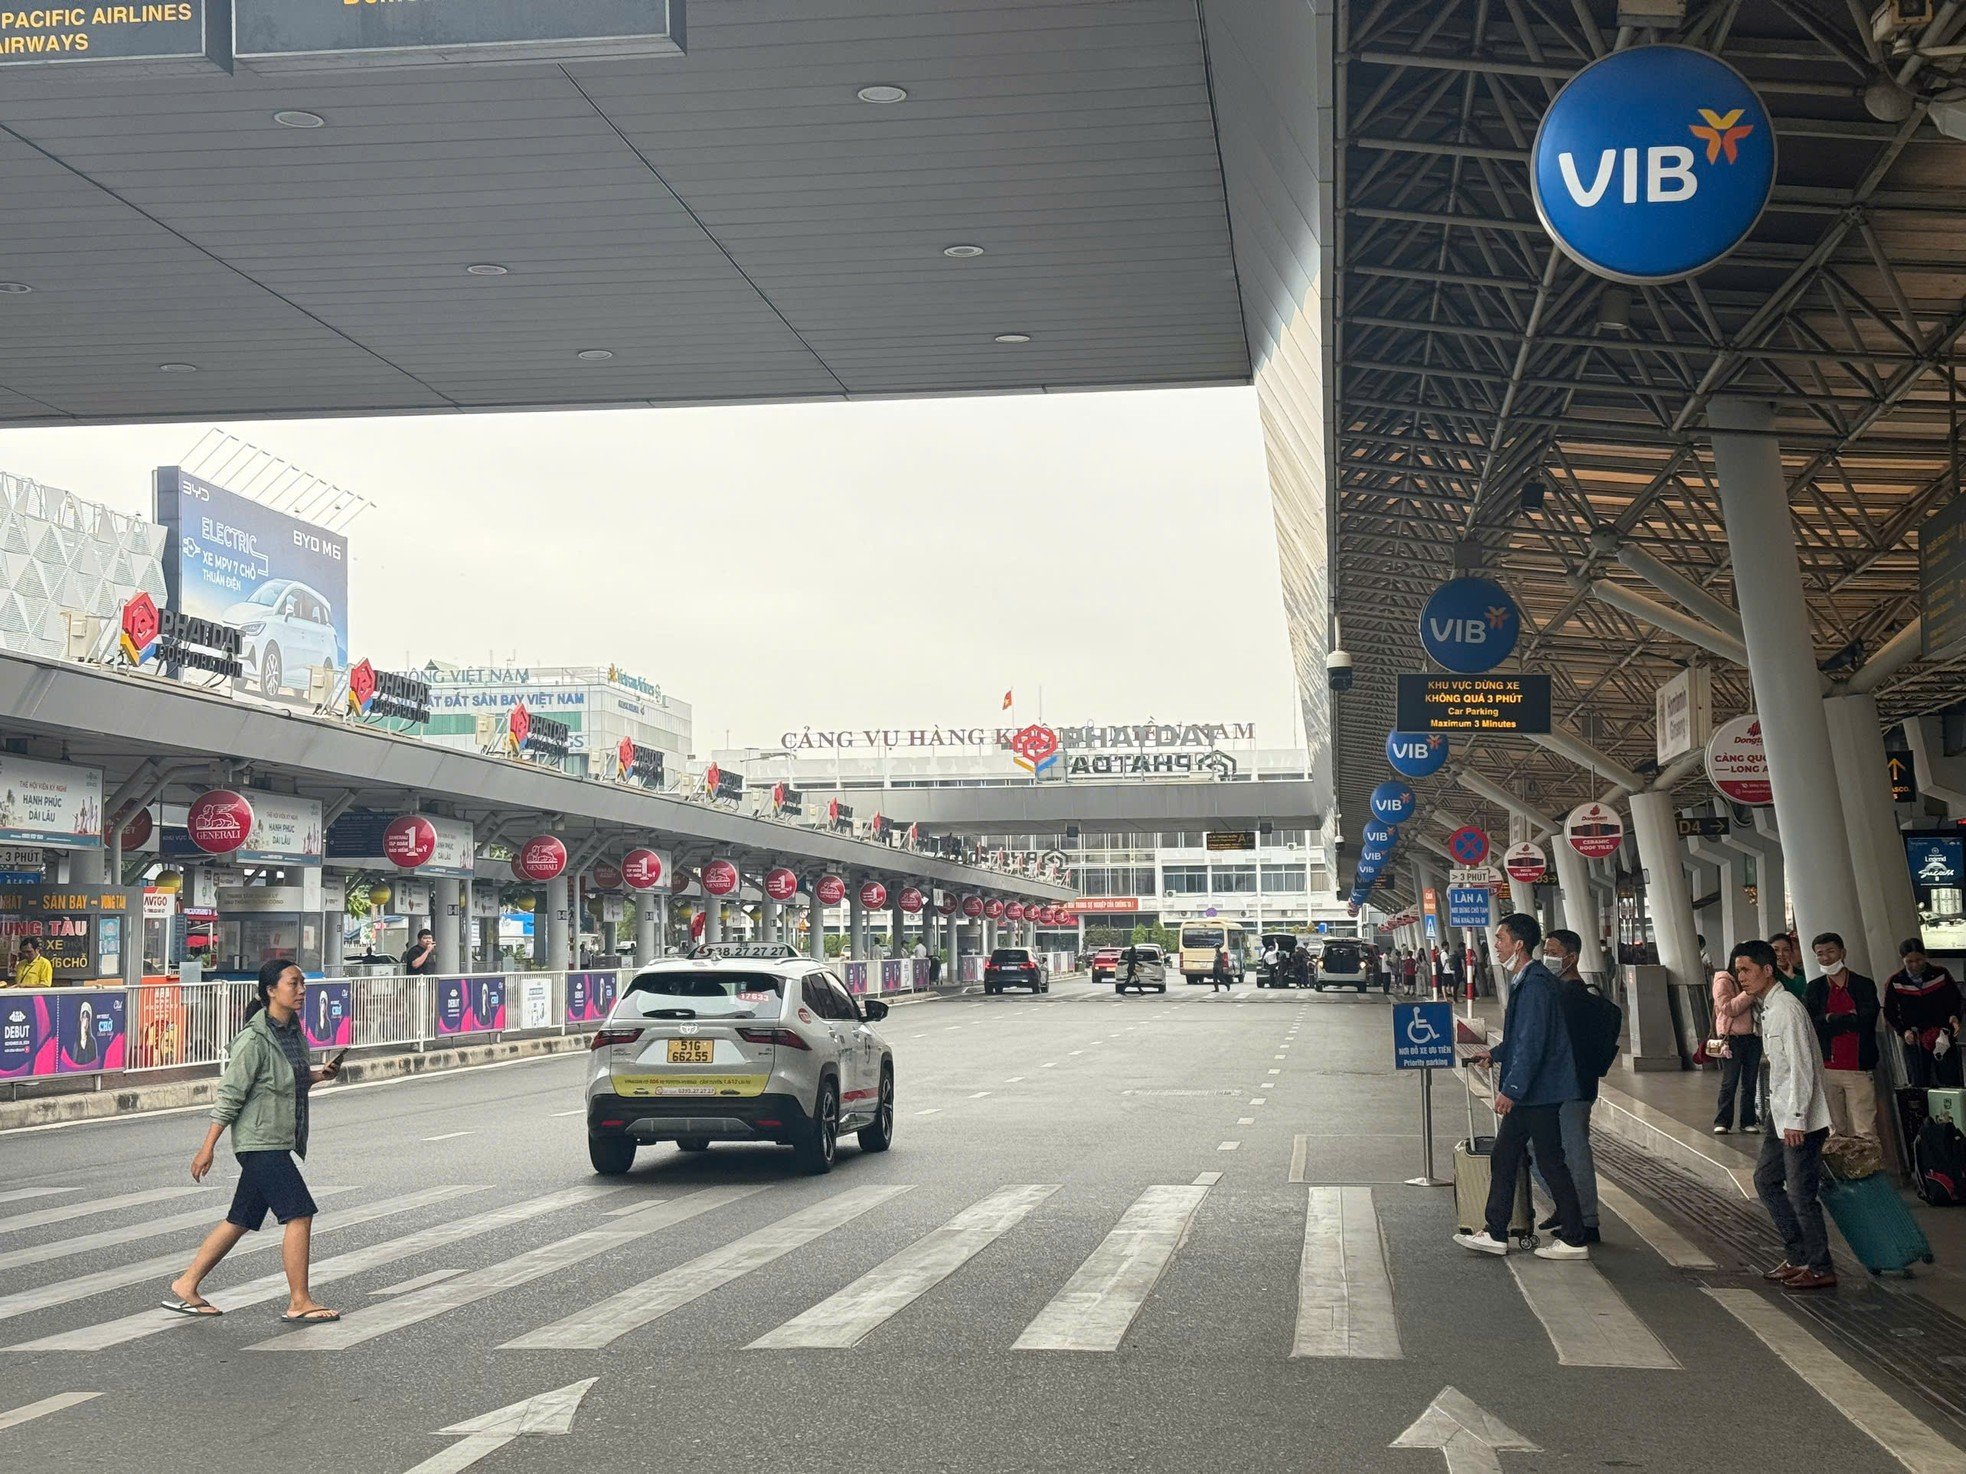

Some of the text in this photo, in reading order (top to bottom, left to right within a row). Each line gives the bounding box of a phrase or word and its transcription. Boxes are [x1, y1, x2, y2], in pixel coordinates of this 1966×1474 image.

[1, 3, 192, 30] PACIFIC AIRLINES
[1558, 145, 1698, 208] VIB
[202, 517, 258, 556] ELECTRIC
[293, 530, 342, 560] BYD M6
[202, 550, 214, 565] XE
[215, 555, 233, 573] MPV
[1430, 618, 1487, 644] VIB
[490, 668, 530, 684] NAM
[1428, 679, 1520, 691] KHU VỰC DỪNG XE
[500, 693, 525, 706] BAY
[557, 693, 585, 705] NAM
[1425, 692, 1523, 704] KHÔNG QUÁ 3 PHÚT
[1447, 707, 1499, 718] Car Parking
[1430, 719, 1517, 728] Maximum 3 Minutes
[781, 725, 853, 749] CẢNG
[863, 729, 900, 751] VỤ
[908, 724, 985, 747] HÀNG
[1392, 743, 1429, 759] VIB
[1730, 765, 1760, 773] LONG
[1376, 799, 1402, 811] VIB
[1679, 820, 1701, 834] D4
[196, 830, 241, 839] GENERALI
[404, 826, 418, 856] 1
[1367, 832, 1388, 841] VIB
[5, 849, 40, 863] 3 PHÚT
[1364, 852, 1382, 861] VIB
[639, 858, 649, 880] 1
[1466, 871, 1487, 881] PHÚT
[778, 875, 787, 893] 1
[69, 894, 88, 909] BAY
[1454, 891, 1484, 903] LÀN A
[50, 916, 87, 937] TÀU
[46, 939, 64, 950] XE
[770, 946, 785, 956] 27
[4, 1025, 30, 1039] DEBUT
[681, 1041, 701, 1051] 51G
[672, 1051, 708, 1062] 662.55
[1403, 1058, 1448, 1067] Priority parking
